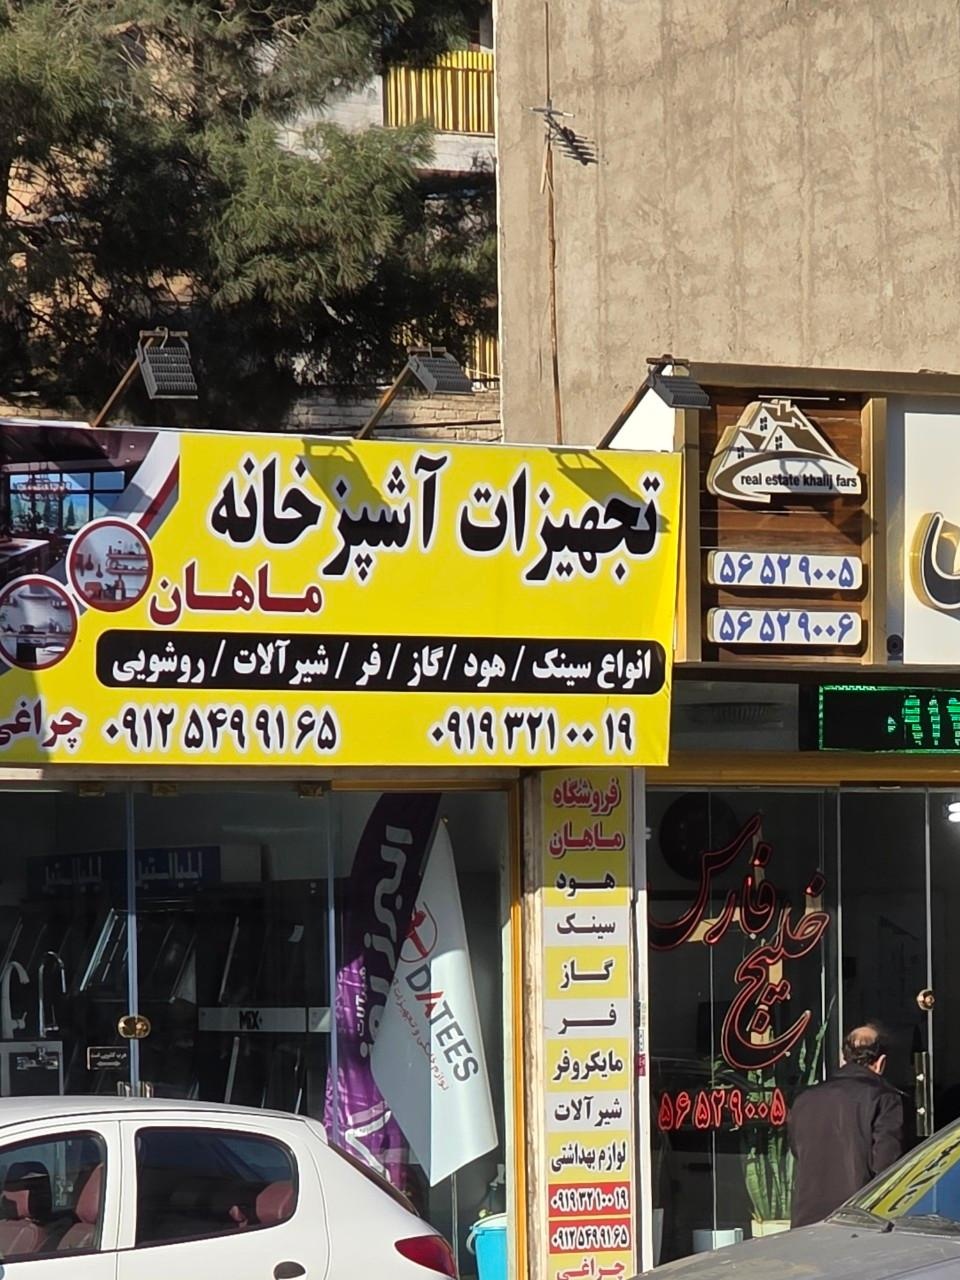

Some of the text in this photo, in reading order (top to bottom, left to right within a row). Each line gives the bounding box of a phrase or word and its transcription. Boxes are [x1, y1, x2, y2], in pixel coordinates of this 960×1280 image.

[741, 474, 857, 490] real estate khalij fars
[211, 454, 661, 581] تجهیزات آشپزخانه
[149, 562, 322, 624] ماهان
[112, 641, 205, 682] روشویی
[356, 642, 381, 685] فر
[407, 646, 444, 686] گاز
[464, 652, 505, 687] هود
[532, 649, 591, 686] سینک
[597, 649, 650, 689] انواع
[553, 778, 621, 816] فروشگاه
[549, 821, 625, 859] ماهان
[556, 873, 616, 897] هود
[557, 912, 616, 940] سینک
[647, 812, 830, 1070] خلیج فارس
[559, 960, 614, 989] گاز
[406, 963, 479, 1082] DATEES
[557, 1003, 617, 1034] فر
[552, 1049, 624, 1080] مایکروفر
[551, 1141, 626, 1172] لوازم بهداشتی
